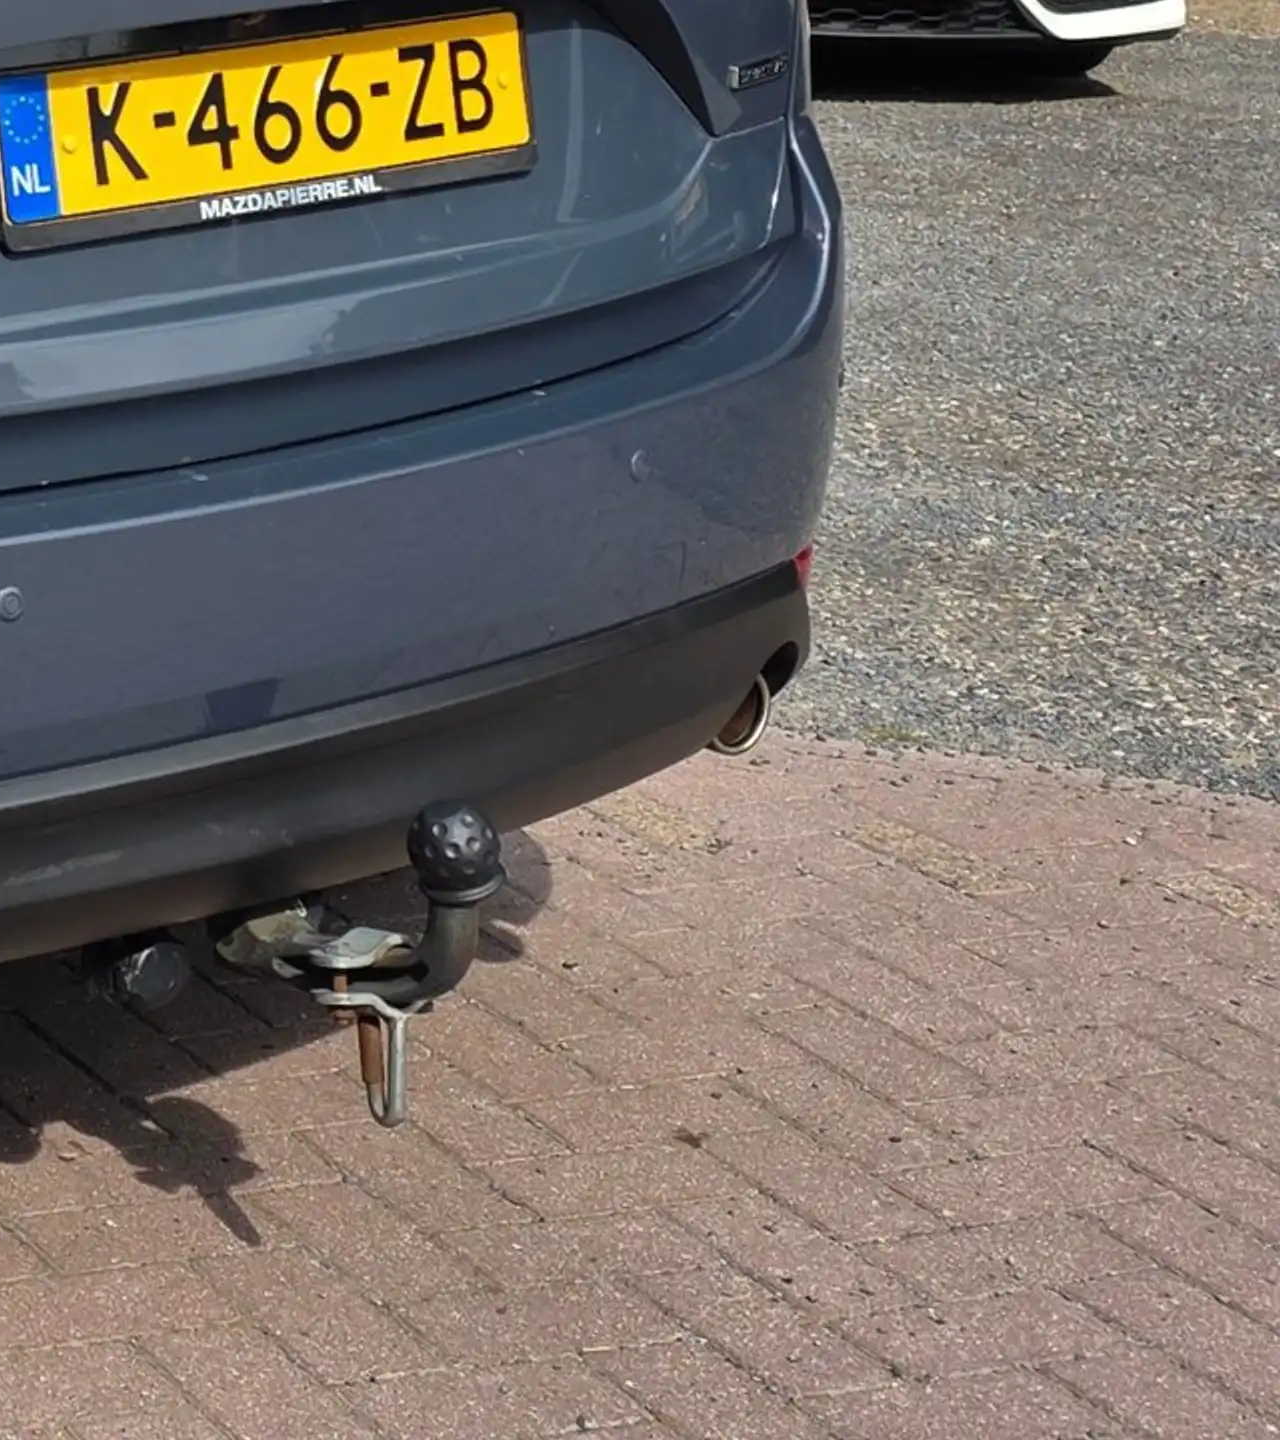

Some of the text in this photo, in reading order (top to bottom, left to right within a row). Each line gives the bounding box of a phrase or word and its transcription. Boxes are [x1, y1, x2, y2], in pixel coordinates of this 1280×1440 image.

[86, 38, 494, 186] K-466-ZB
[11, 164, 51, 199] NL
[199, 176, 382, 221] MAZDAPIERRE.NL
